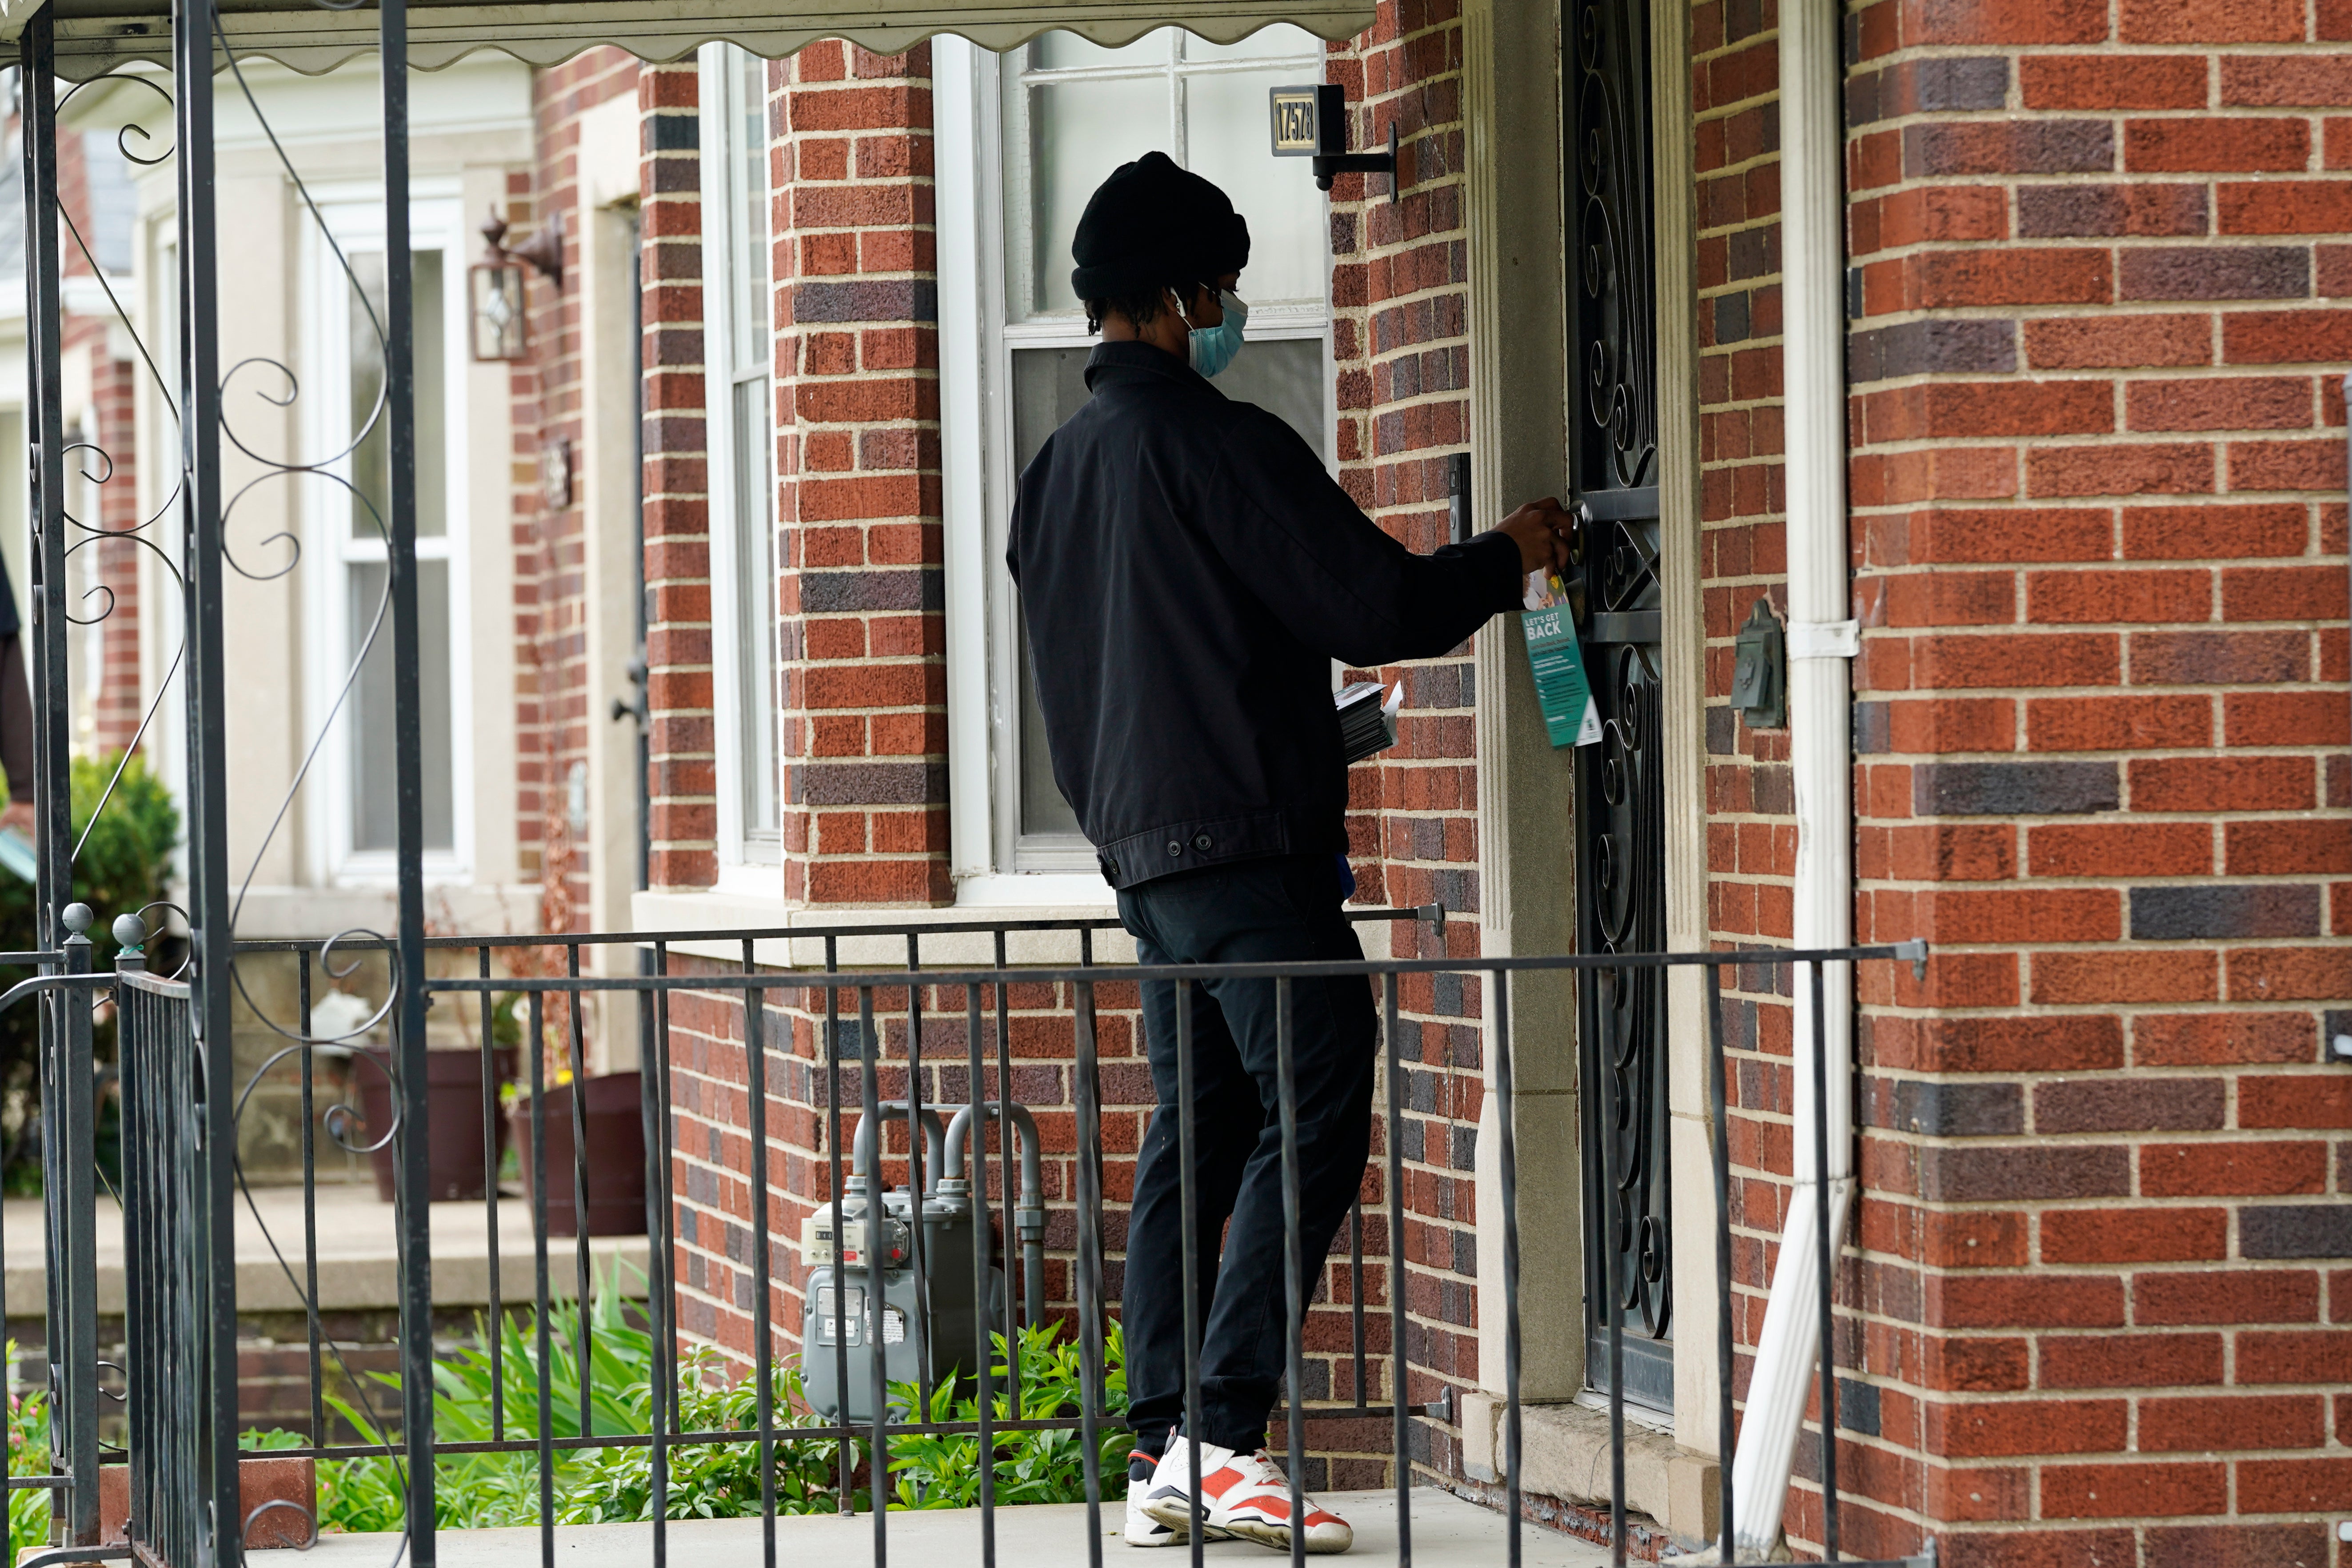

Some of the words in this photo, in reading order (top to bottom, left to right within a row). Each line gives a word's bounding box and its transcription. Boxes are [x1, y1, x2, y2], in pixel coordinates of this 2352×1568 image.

[1276, 102, 1313, 141] 17578
[1524, 616, 1545, 626] LET'S
[1545, 612, 1559, 622] GET
[1526, 620, 1562, 640] BACK
